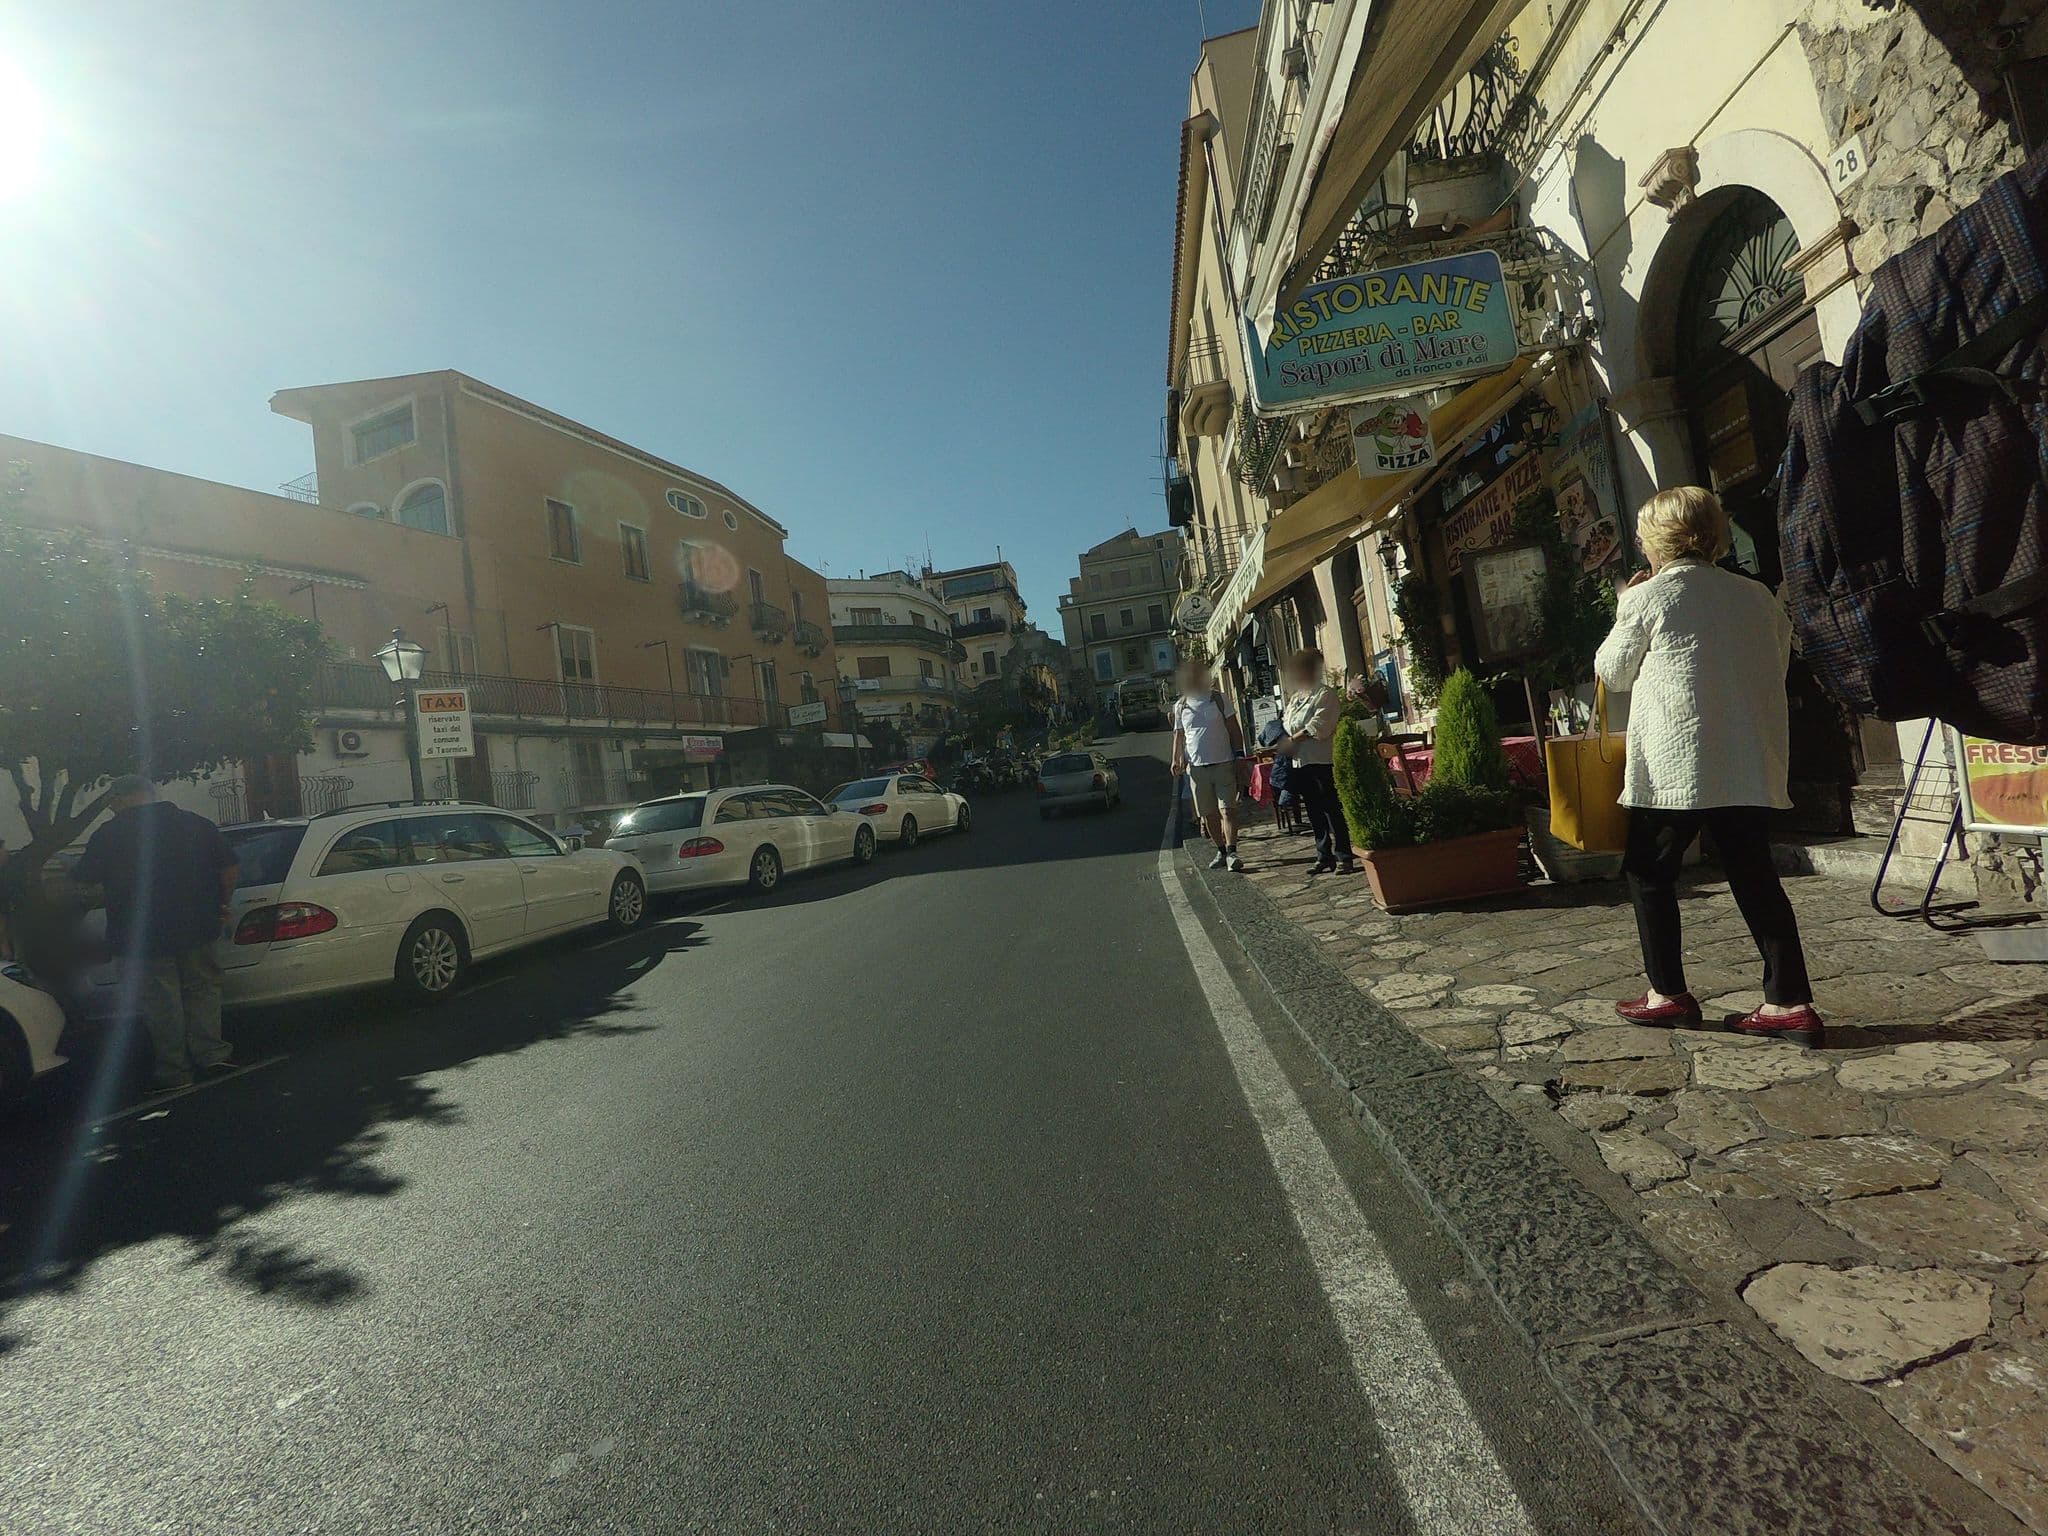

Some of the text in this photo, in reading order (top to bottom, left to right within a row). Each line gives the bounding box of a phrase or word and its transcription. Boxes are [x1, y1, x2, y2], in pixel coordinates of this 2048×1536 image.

[1835, 149, 1858, 182] 28
[1270, 272, 1492, 350] RISTORANTE
[1298, 323, 1396, 357] PIZZERIA
[1411, 309, 1461, 336] BAR
[1280, 332, 1488, 388] Sapori di Mare
[1394, 368, 1411, 378] da
[1414, 361, 1452, 376] Franco
[1455, 358, 1464, 367] e
[1377, 449, 1430, 469] PIZZA
[1446, 488, 1501, 548] RISTORANTE
[1490, 510, 1513, 545] BAR
[423, 696, 463, 709] TAXI
[428, 715, 460, 723] riservato
